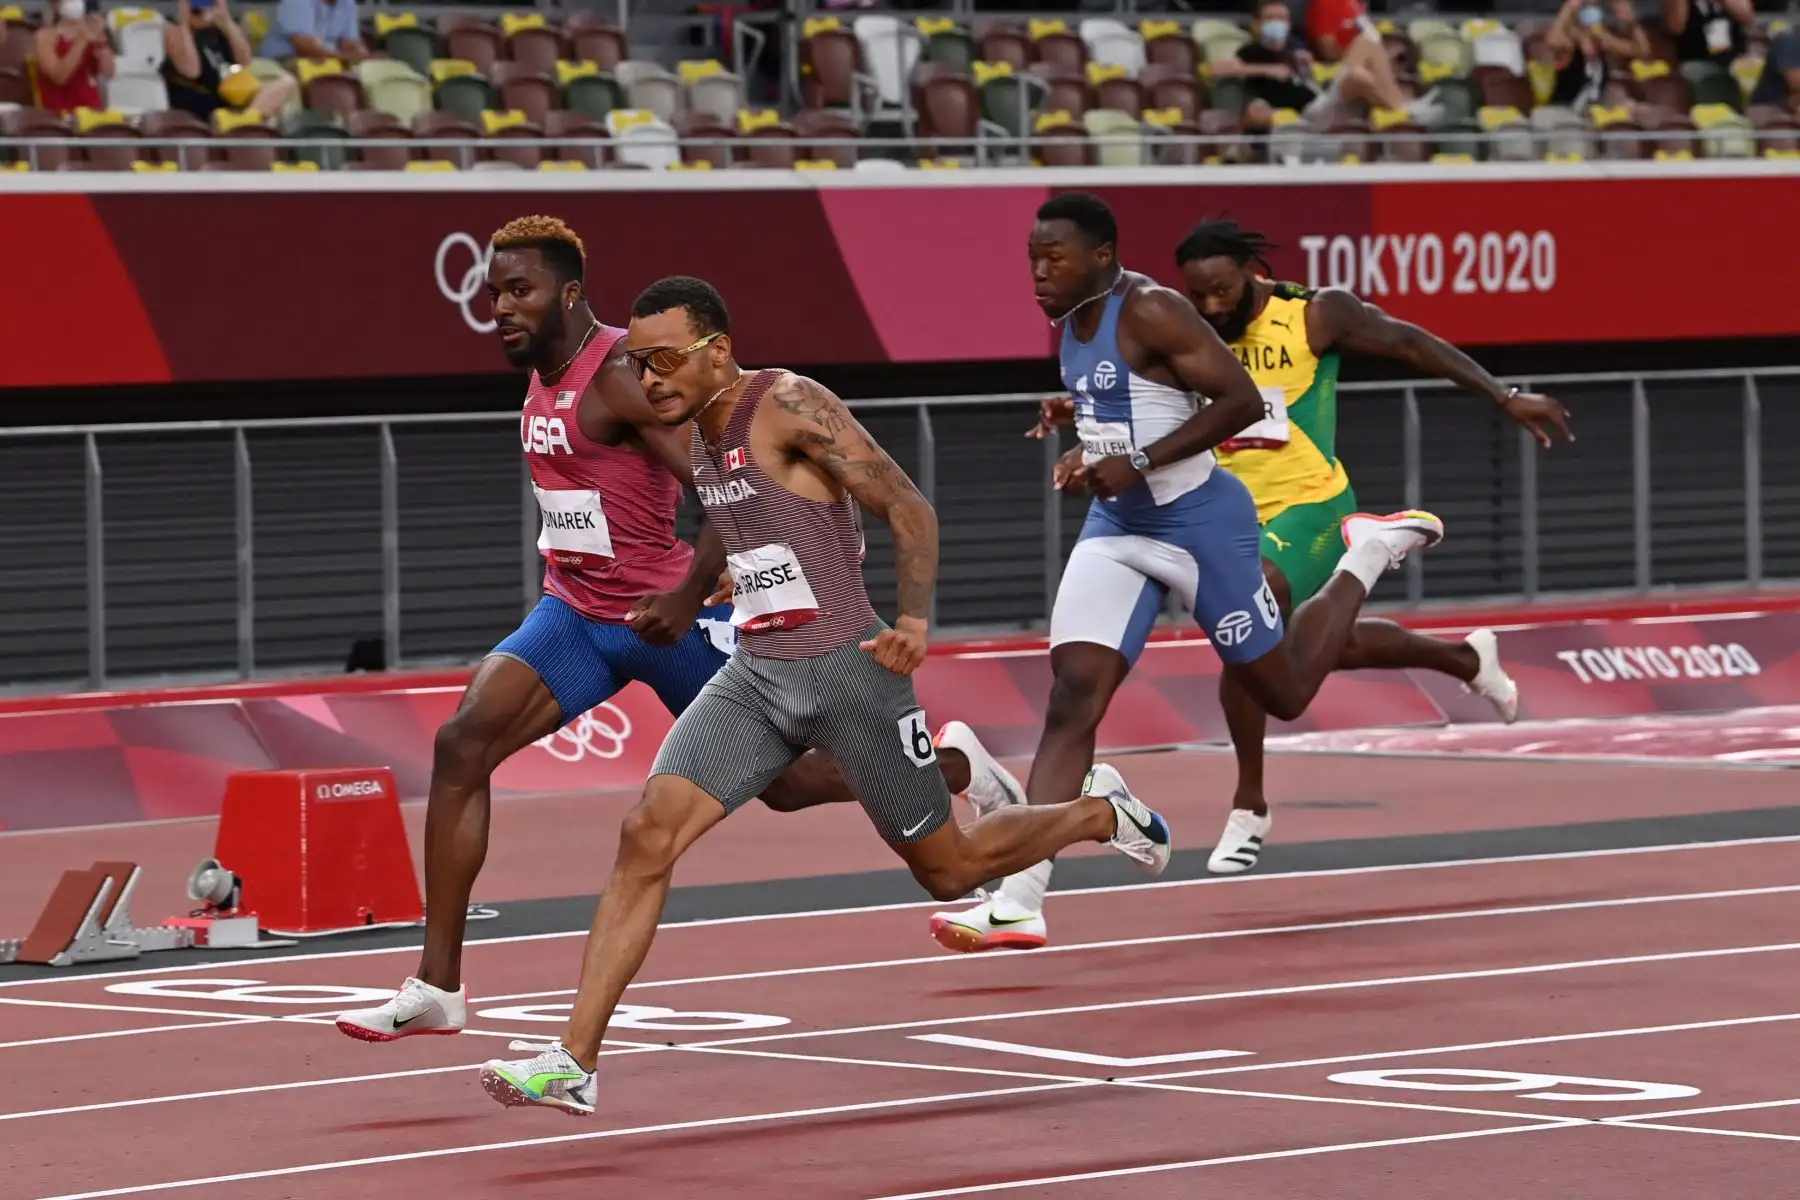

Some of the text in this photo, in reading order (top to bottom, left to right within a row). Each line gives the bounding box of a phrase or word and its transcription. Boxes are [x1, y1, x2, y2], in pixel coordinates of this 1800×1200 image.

[1299, 229, 1557, 296] TOKYO 2020
[1232, 343, 1294, 371] AICA
[520, 414, 574, 455] USA
[696, 477, 758, 507] CANADA
[1556, 642, 1761, 684] TOKYO 2020
[911, 717, 932, 760] 6
[332, 780, 383, 798] OMEGA
